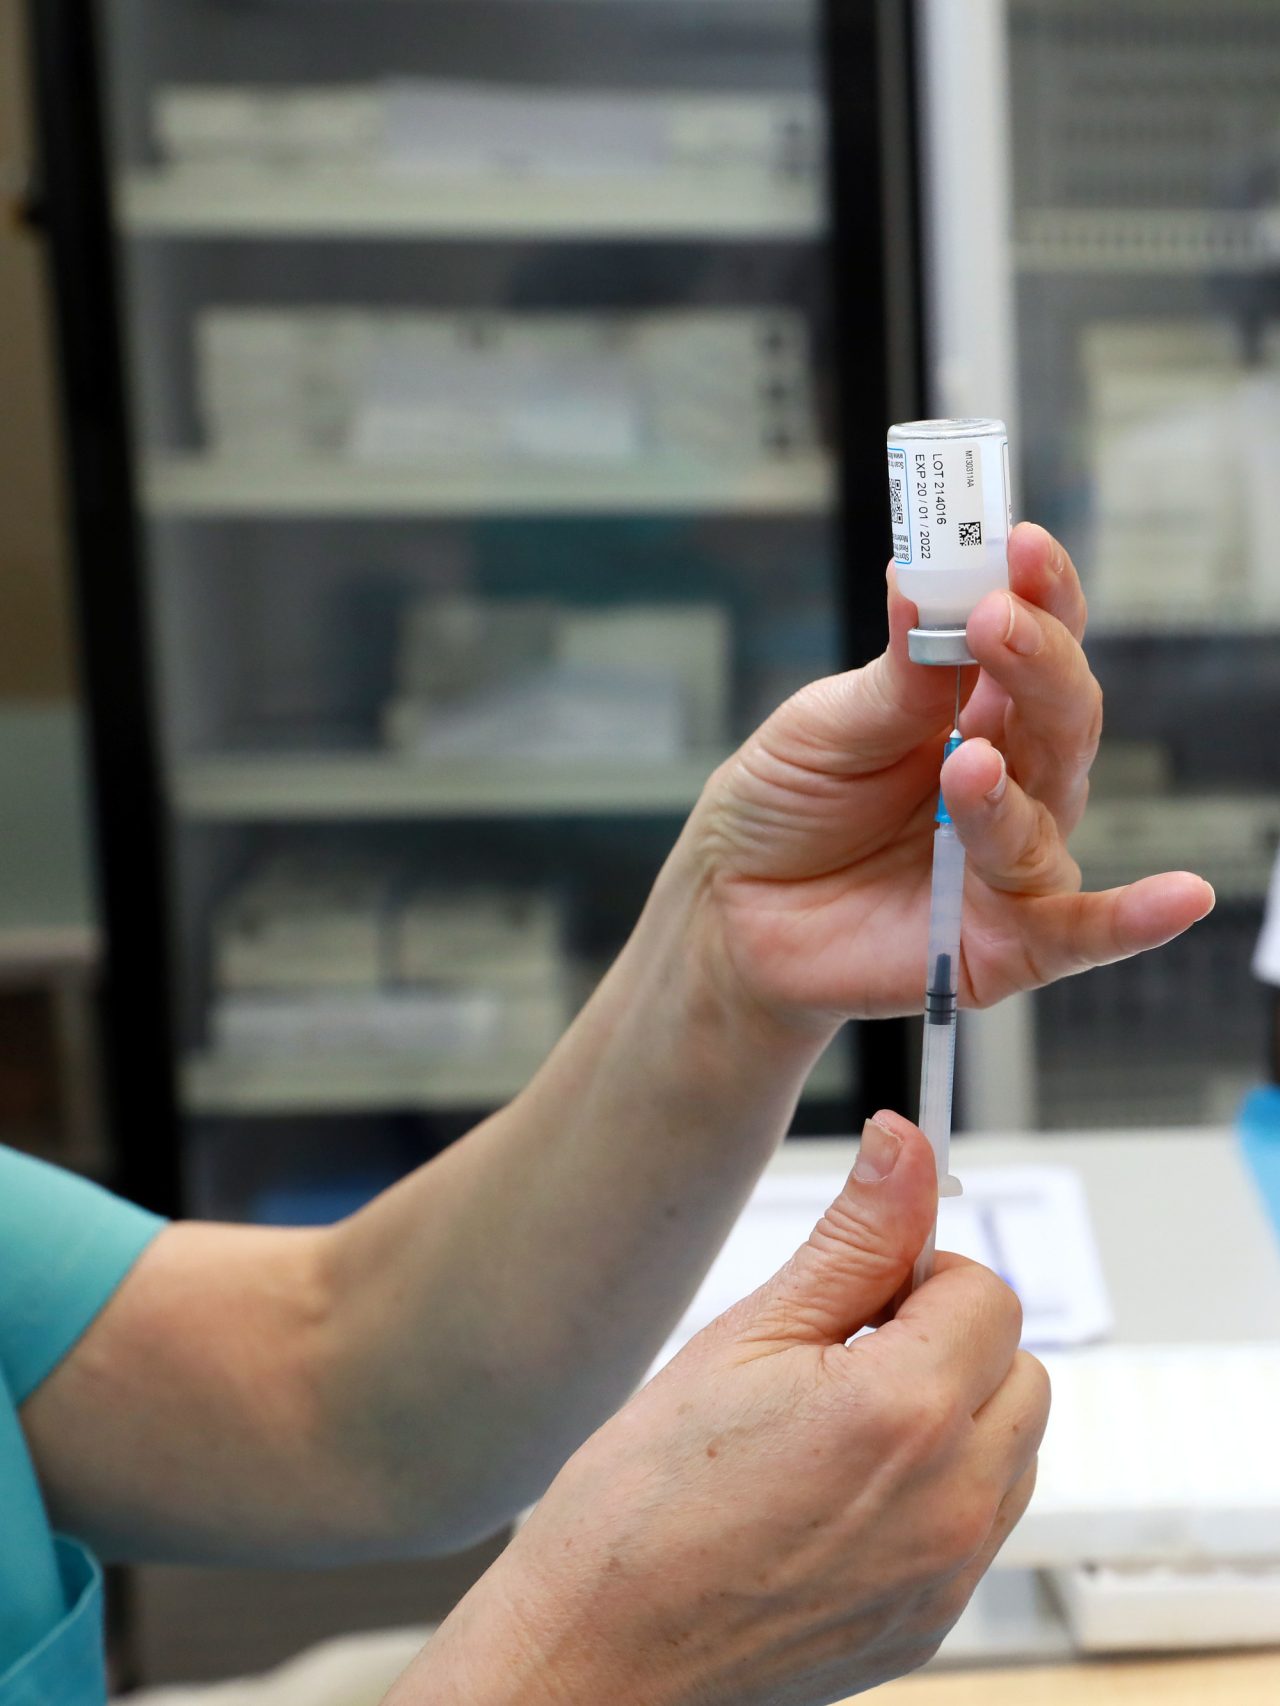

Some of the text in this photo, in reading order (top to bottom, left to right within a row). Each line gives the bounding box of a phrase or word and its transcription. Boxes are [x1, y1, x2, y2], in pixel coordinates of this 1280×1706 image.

[915, 454, 926, 479] EXP
[916, 482, 927, 497] 20
[932, 453, 947, 525] LOT 214016
[918, 507, 928, 519] 01
[920, 531, 931, 560] 2022
